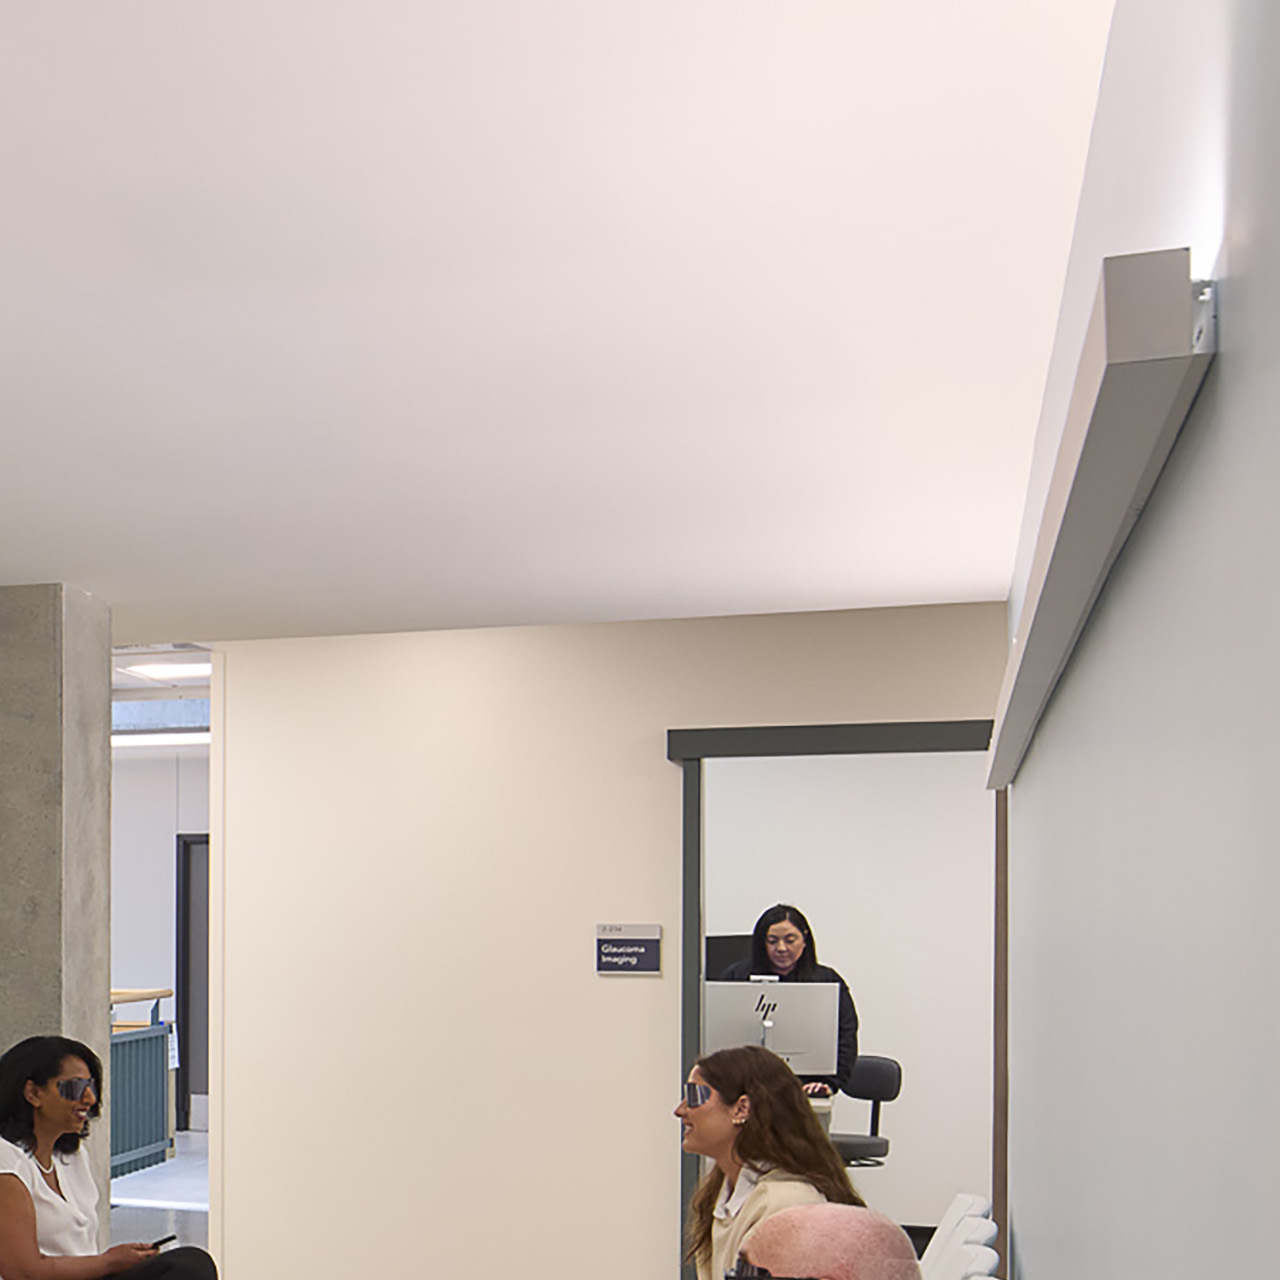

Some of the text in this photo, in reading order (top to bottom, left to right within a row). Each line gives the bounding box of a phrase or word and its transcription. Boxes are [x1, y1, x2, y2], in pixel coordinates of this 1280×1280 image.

[601, 943, 645, 953] Glaucoma
[601, 954, 637, 966] Imaging
[755, 993, 777, 1021] hp
